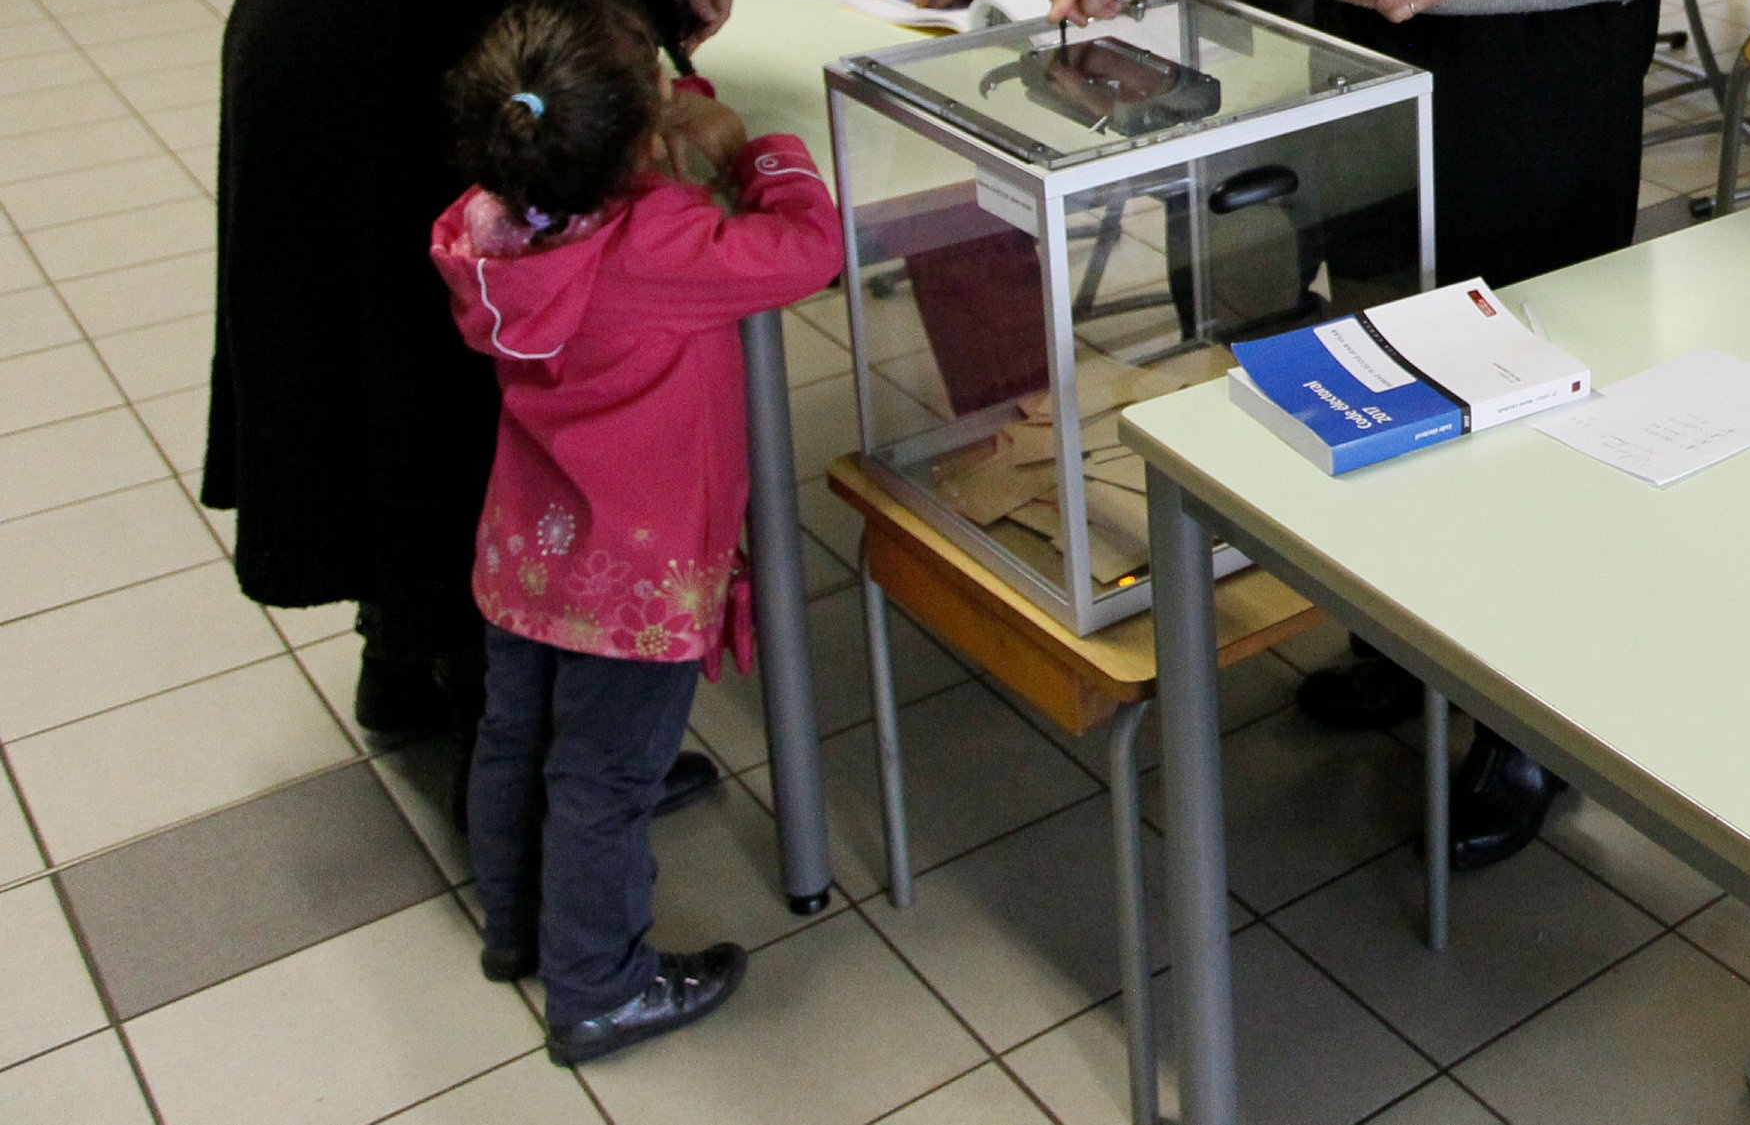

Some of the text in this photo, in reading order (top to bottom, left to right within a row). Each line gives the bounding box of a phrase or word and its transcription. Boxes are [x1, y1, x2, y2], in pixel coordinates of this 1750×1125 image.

[1302, 380, 1372, 430] Code électoral
[1361, 406, 1393, 424] 2017
